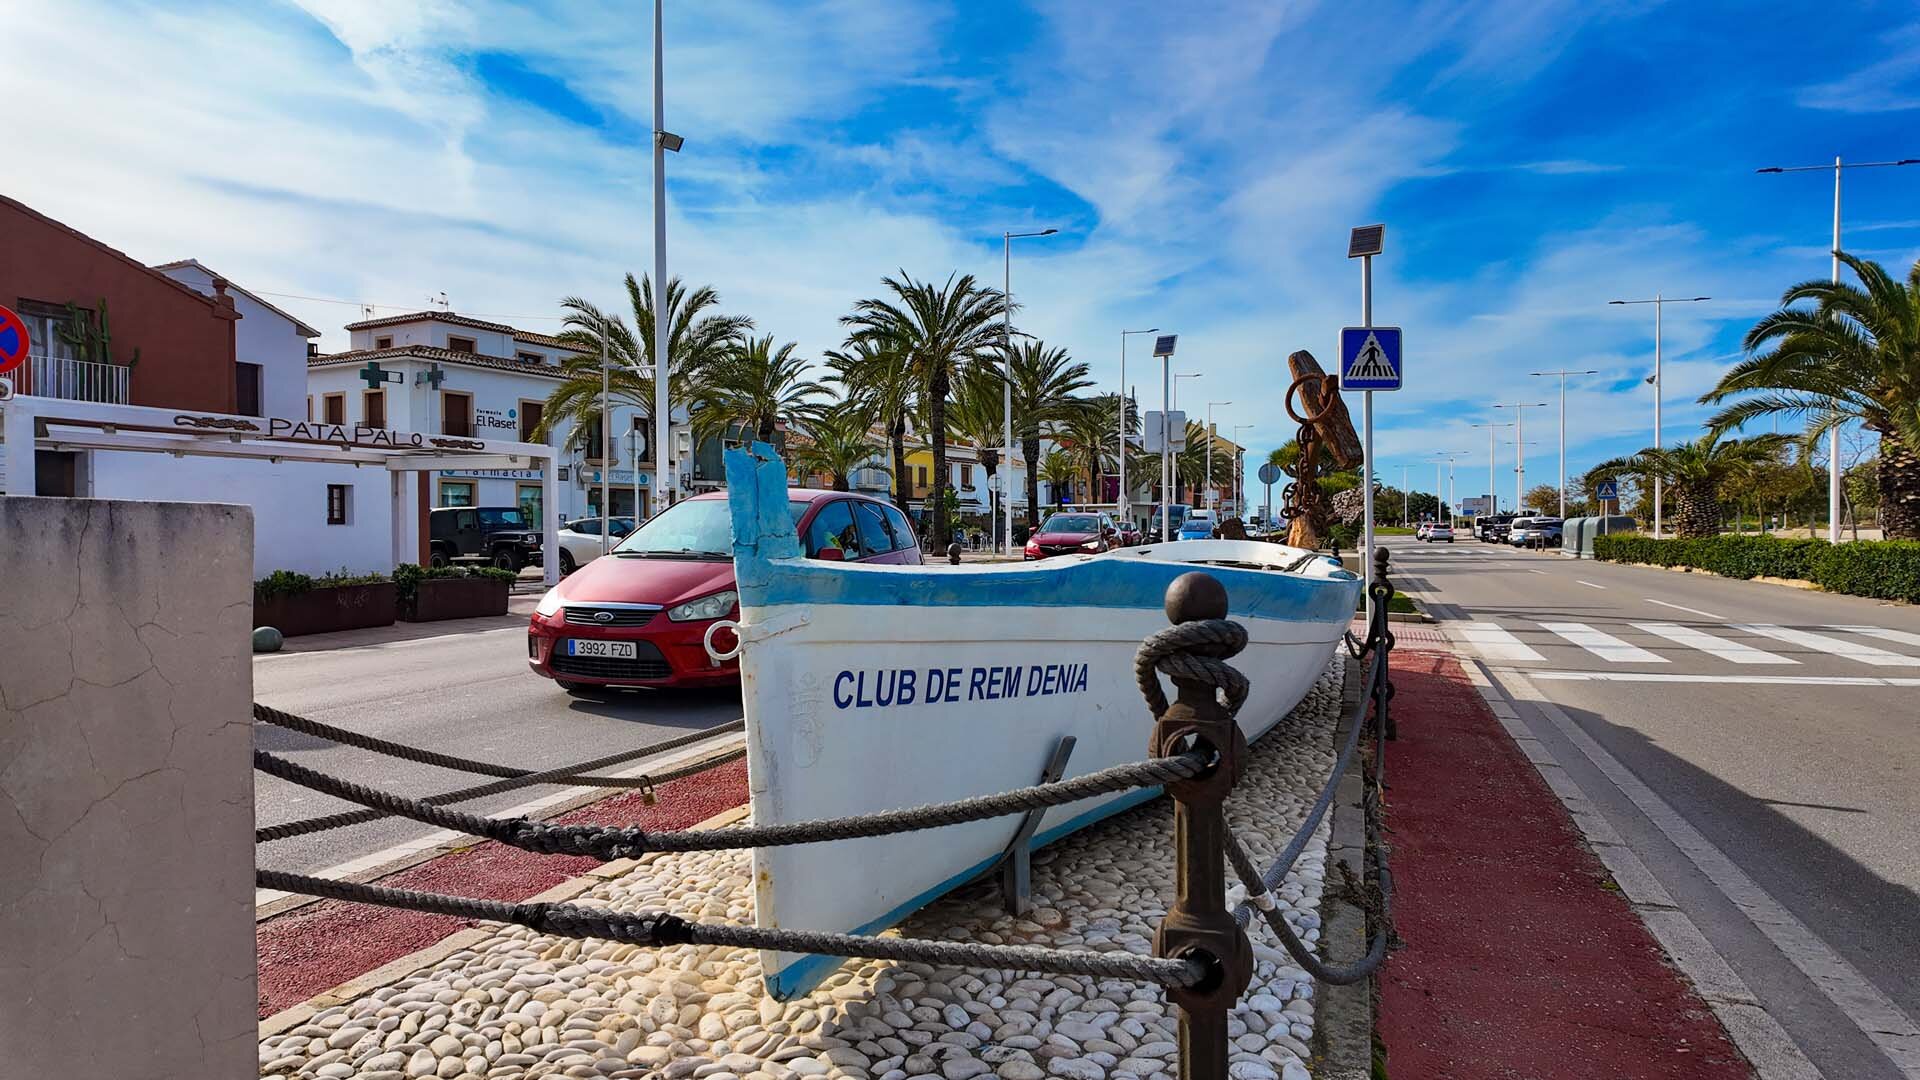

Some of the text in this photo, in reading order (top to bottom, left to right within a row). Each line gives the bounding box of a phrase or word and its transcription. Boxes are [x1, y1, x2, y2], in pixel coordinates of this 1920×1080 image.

[265, 418, 347, 442] PATA
[476, 415, 517, 430] El Raset
[579, 642, 632, 657] 3992 FZD
[833, 663, 1089, 710] CLUB DE REM DENIA
